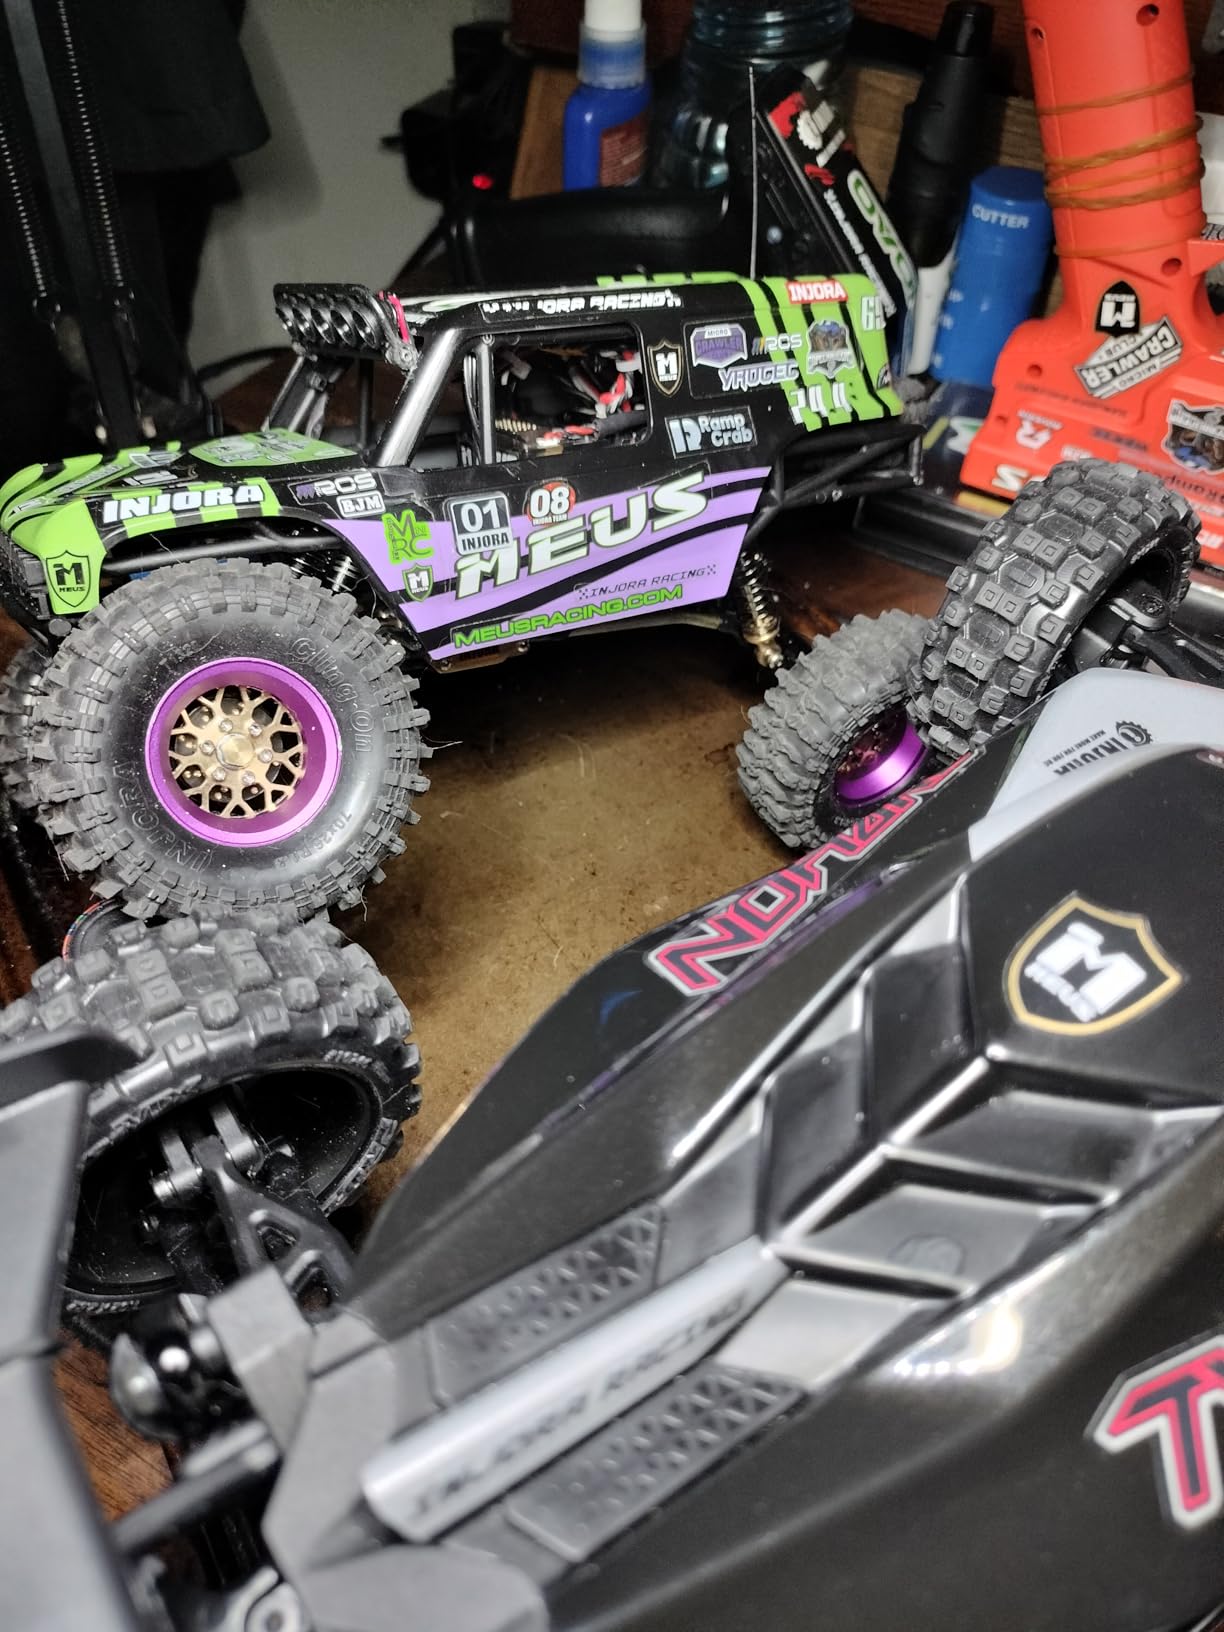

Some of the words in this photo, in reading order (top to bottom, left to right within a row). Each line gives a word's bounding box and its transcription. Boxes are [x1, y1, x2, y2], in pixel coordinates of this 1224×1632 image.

[972, 203, 1029, 229] CUTTER
[788, 281, 845, 302] INJORA
[694, 335, 743, 353] CRAWLER
[1083, 326, 1176, 389] CRAWLER
[1119, 364, 1159, 388] MICRO
[699, 413, 746, 434] Ramp
[711, 427, 753, 447] Crab
[103, 485, 264, 523] INJORA
[341, 495, 382, 513] BJM
[530, 486, 570, 518] 08
[461, 500, 502, 533] 01
[552, 513, 568, 523] TEAM
[456, 470, 708, 600] MEUS
[461, 532, 510, 552] INJORA
[590, 579, 648, 598] INJORA
[651, 568, 705, 586] RACING
[454, 584, 684, 648] MEUSRACING.COM
[1094, 1333, 1224, 1530] T
